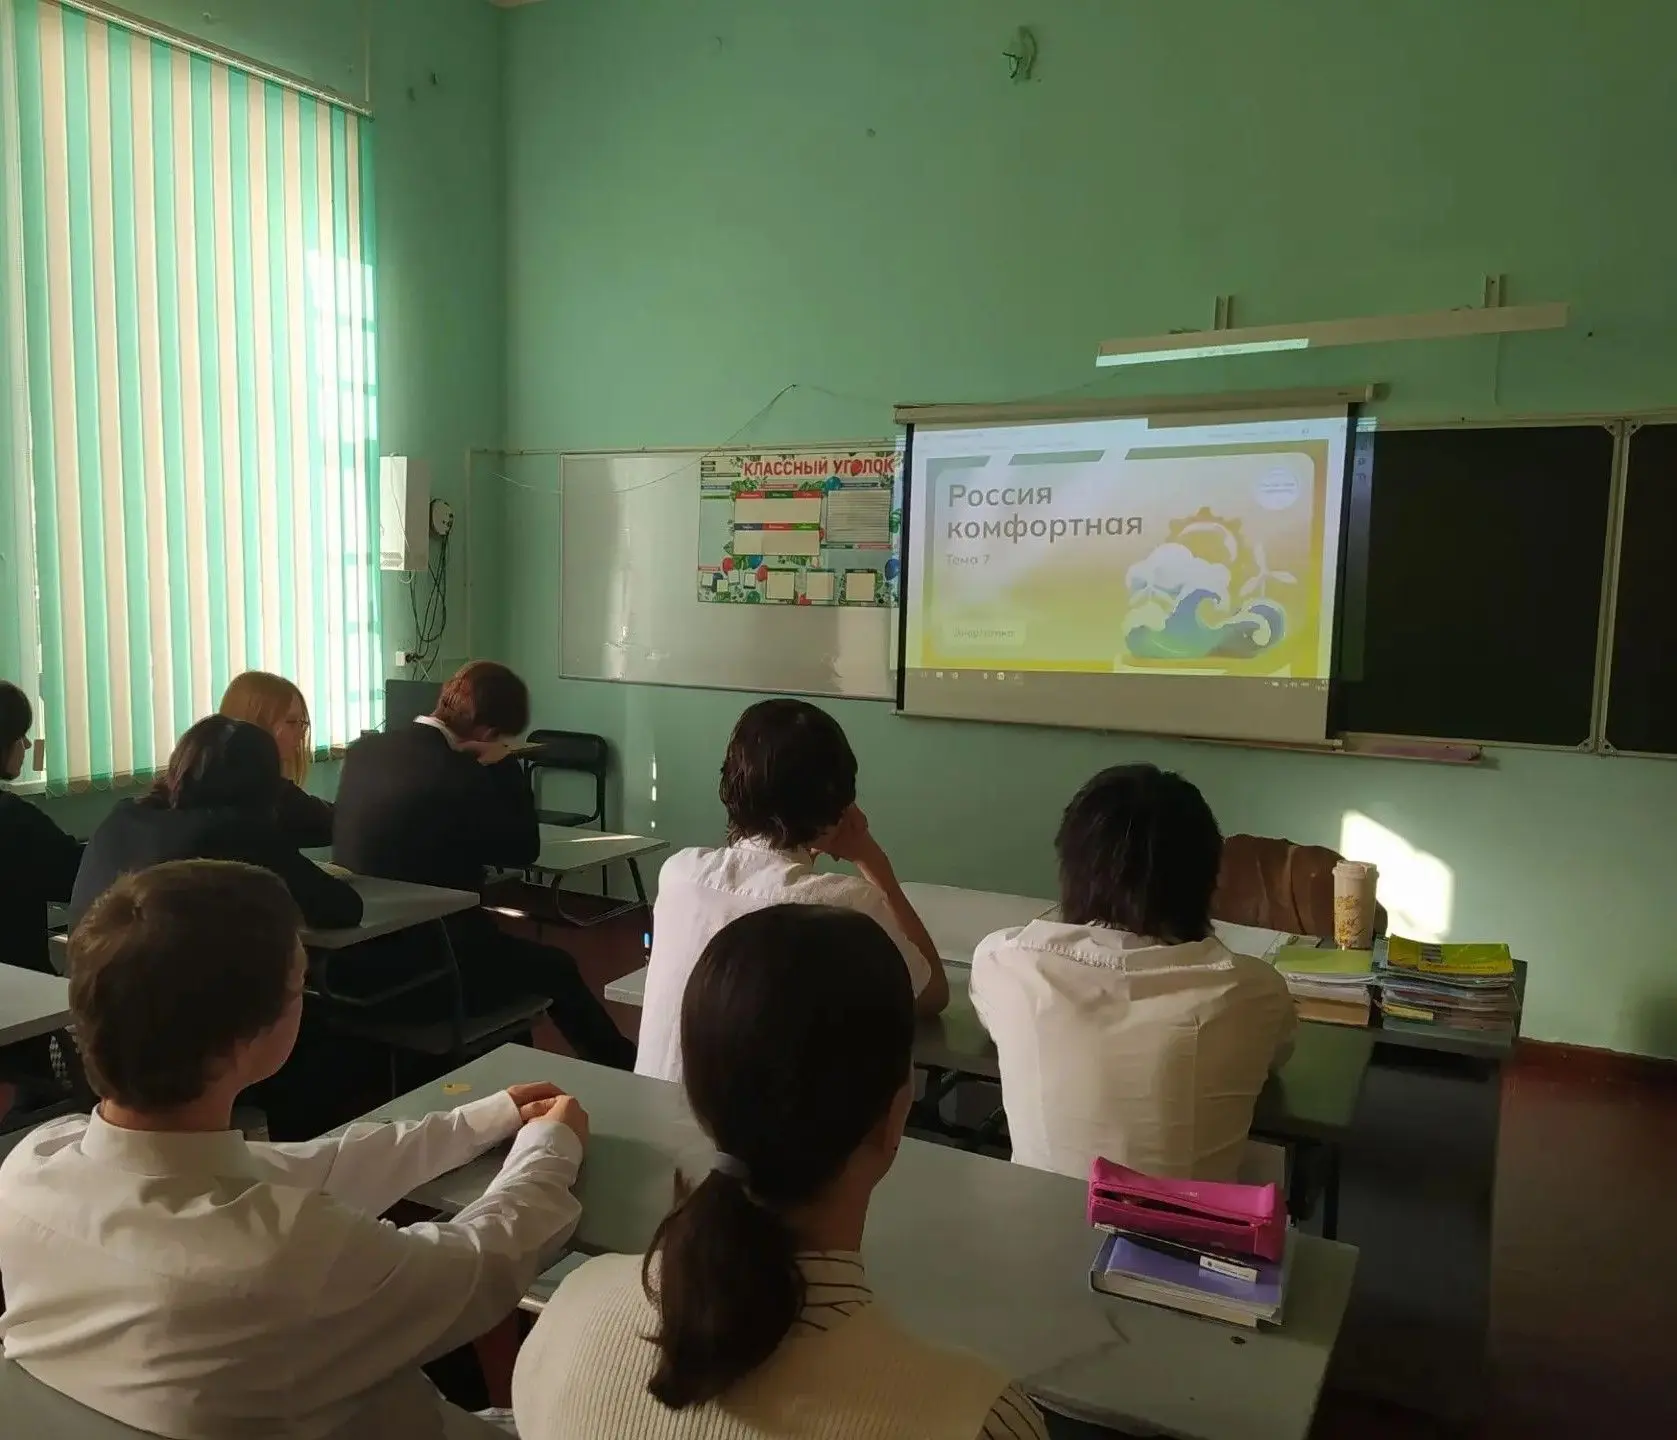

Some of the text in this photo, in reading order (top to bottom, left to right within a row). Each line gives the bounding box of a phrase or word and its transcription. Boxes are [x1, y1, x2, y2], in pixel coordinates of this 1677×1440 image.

[744, 456, 894, 477] КЛАССНЫЙ УГОЛОК
[949, 483, 1053, 508] Россия
[948, 512, 1143, 543] комфортная
[946, 553, 991, 566] Тема 7
